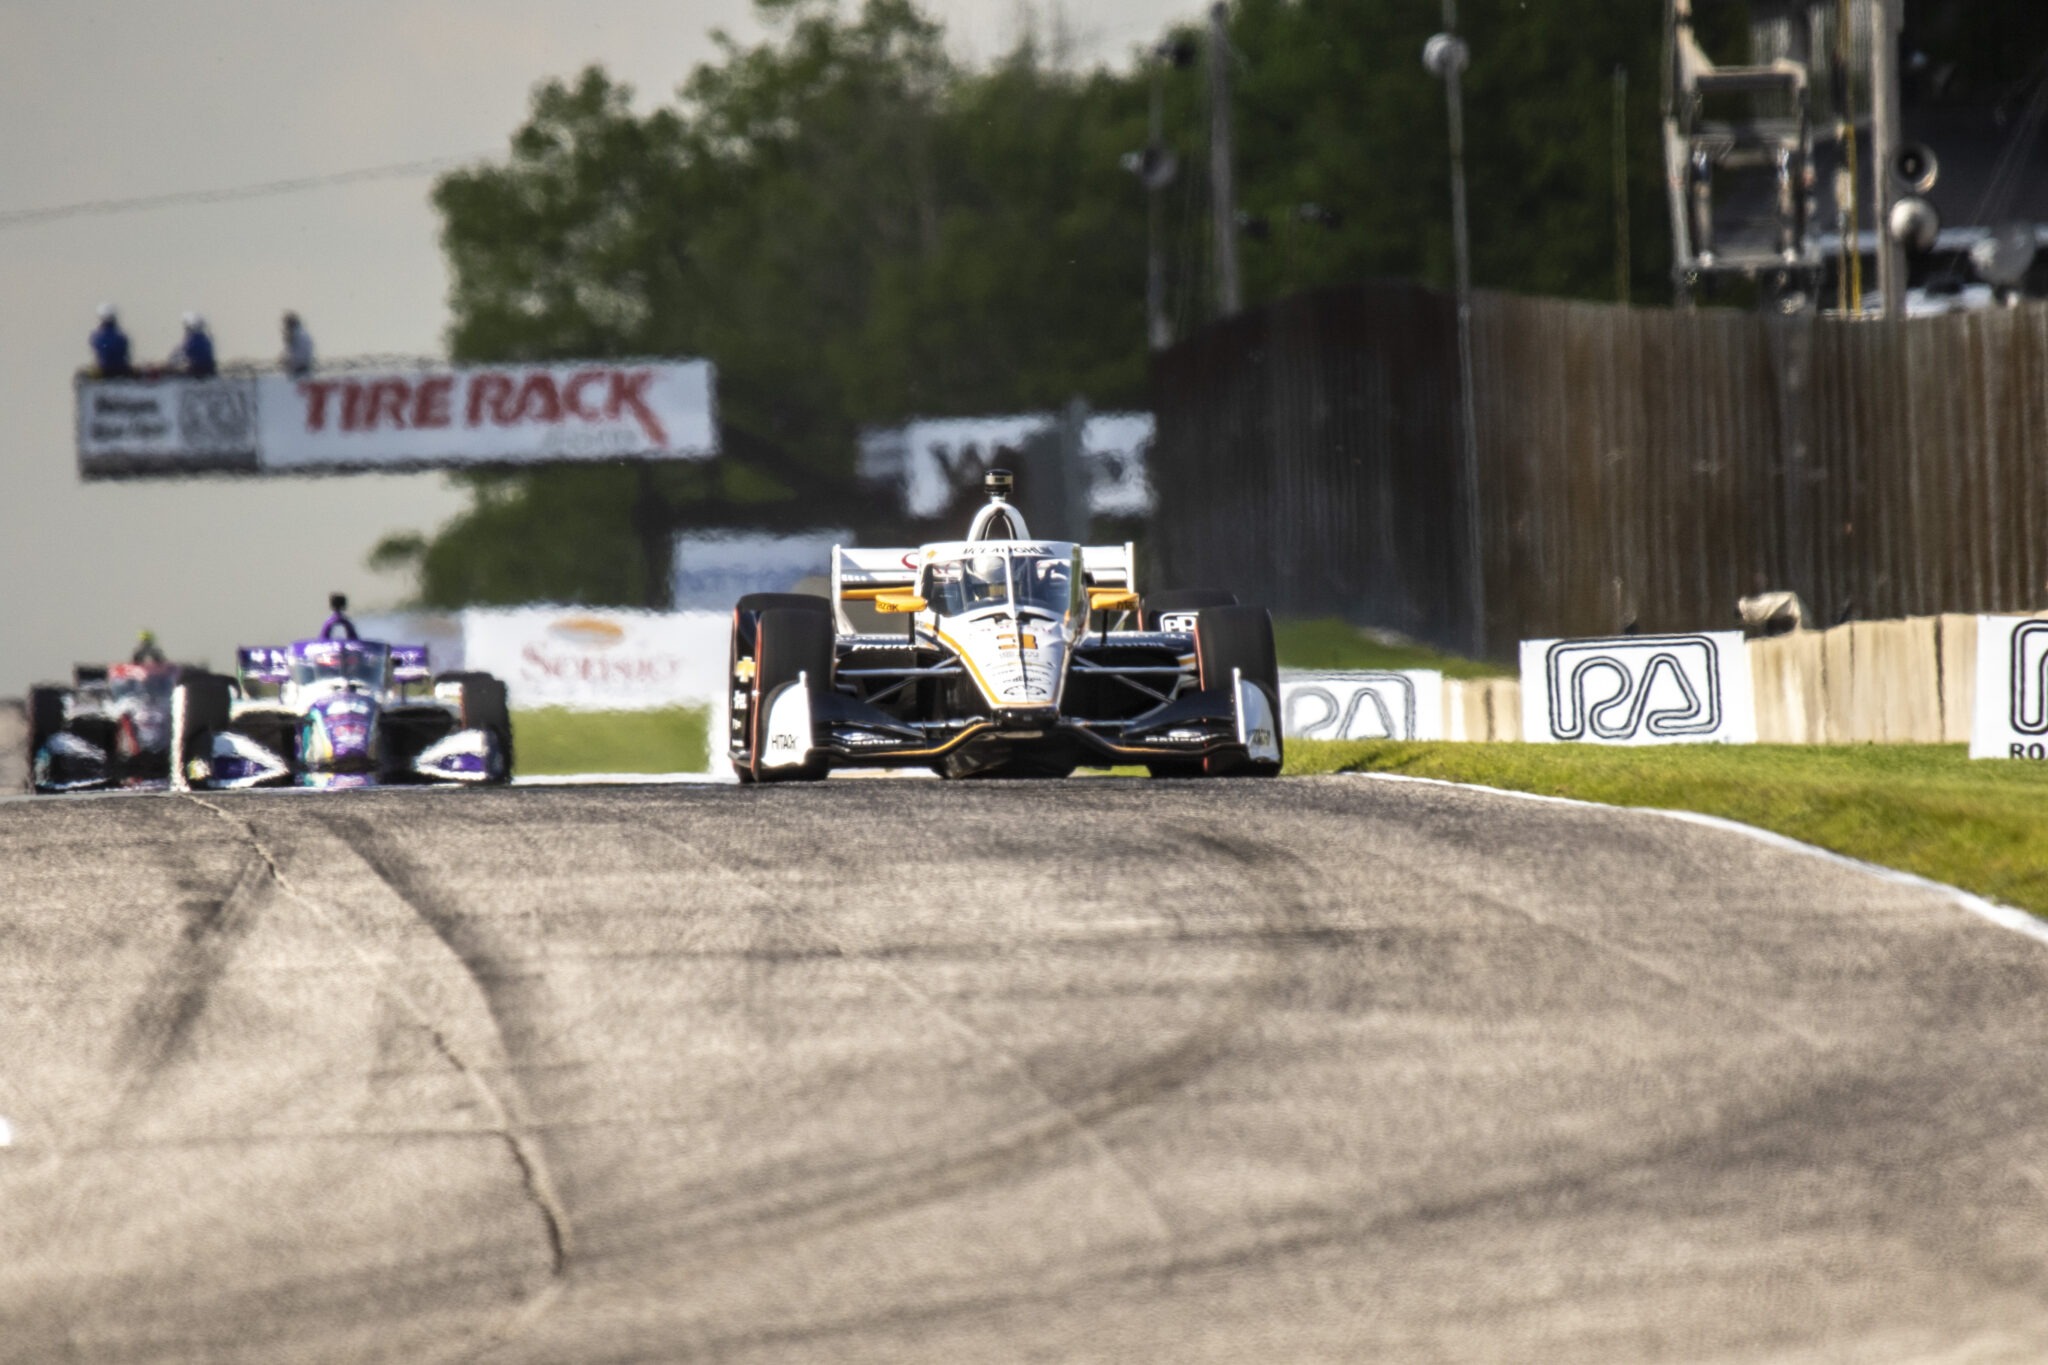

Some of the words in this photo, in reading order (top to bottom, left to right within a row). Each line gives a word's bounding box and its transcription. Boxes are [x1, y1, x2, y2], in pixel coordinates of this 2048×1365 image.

[300, 375, 454, 432] TIRE
[465, 369, 669, 446] RACK
[2009, 742, 2048, 761] RO
